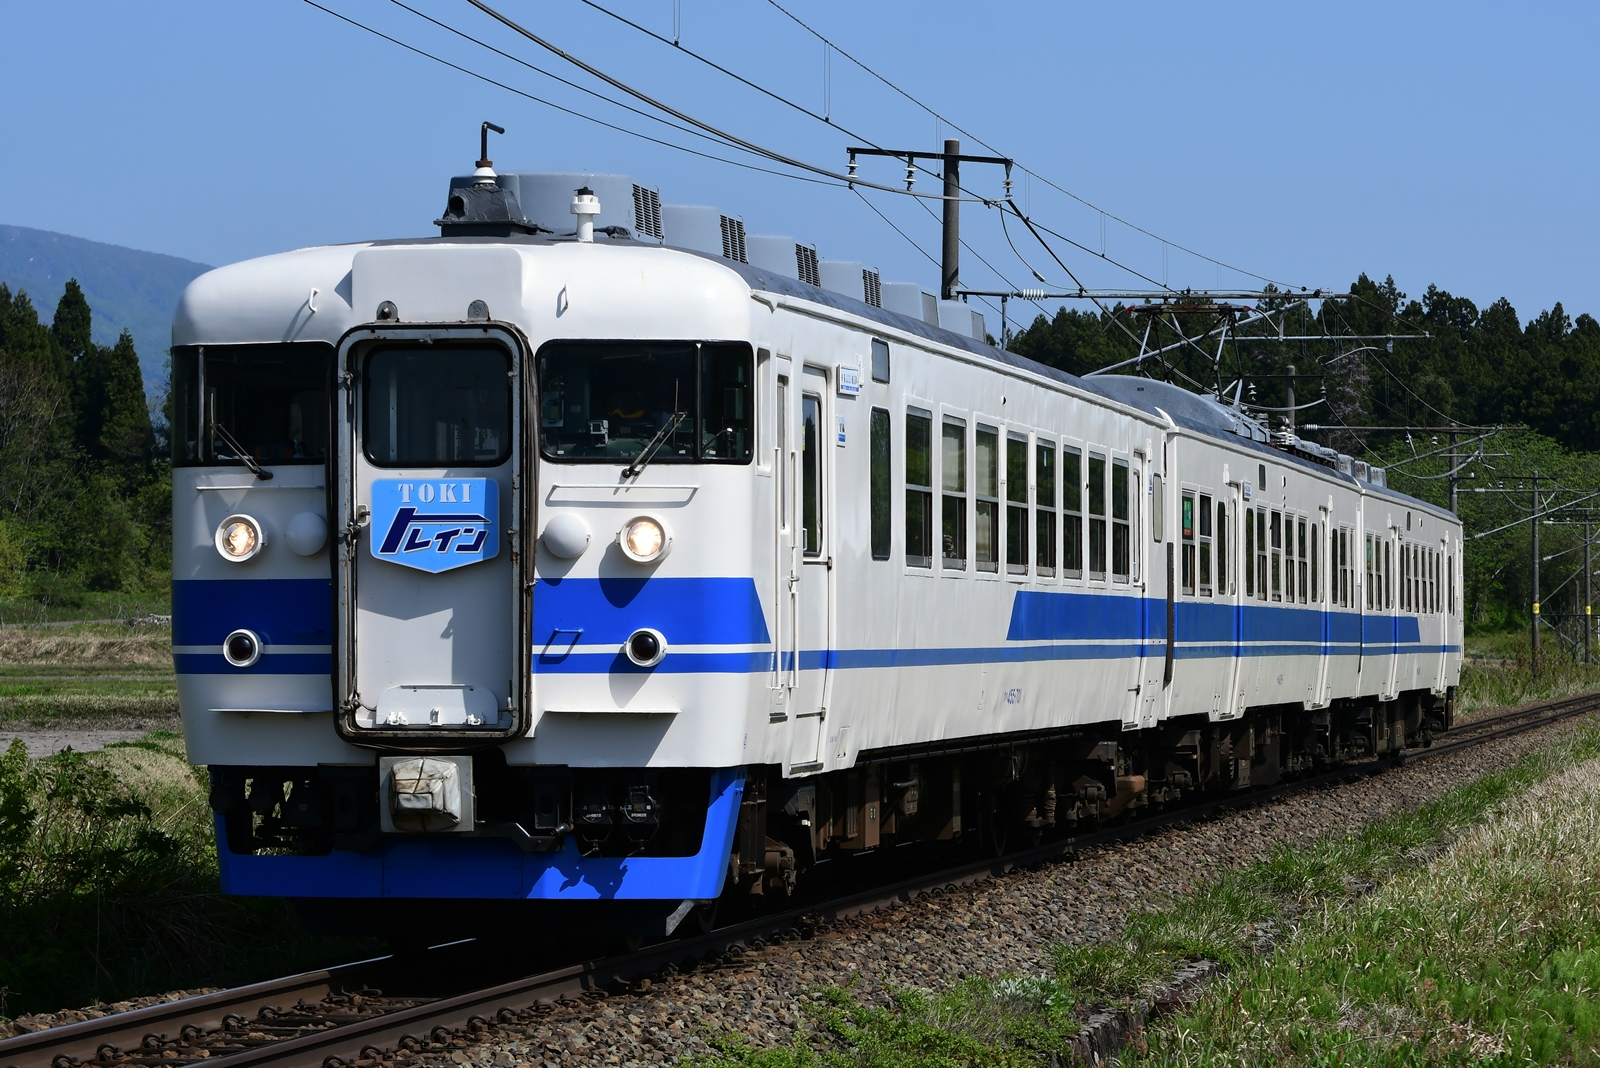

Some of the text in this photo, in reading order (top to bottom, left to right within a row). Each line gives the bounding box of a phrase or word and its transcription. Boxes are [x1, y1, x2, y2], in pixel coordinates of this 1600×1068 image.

[398, 483, 471, 503] TOKI
[378, 506, 491, 555] トレイン
